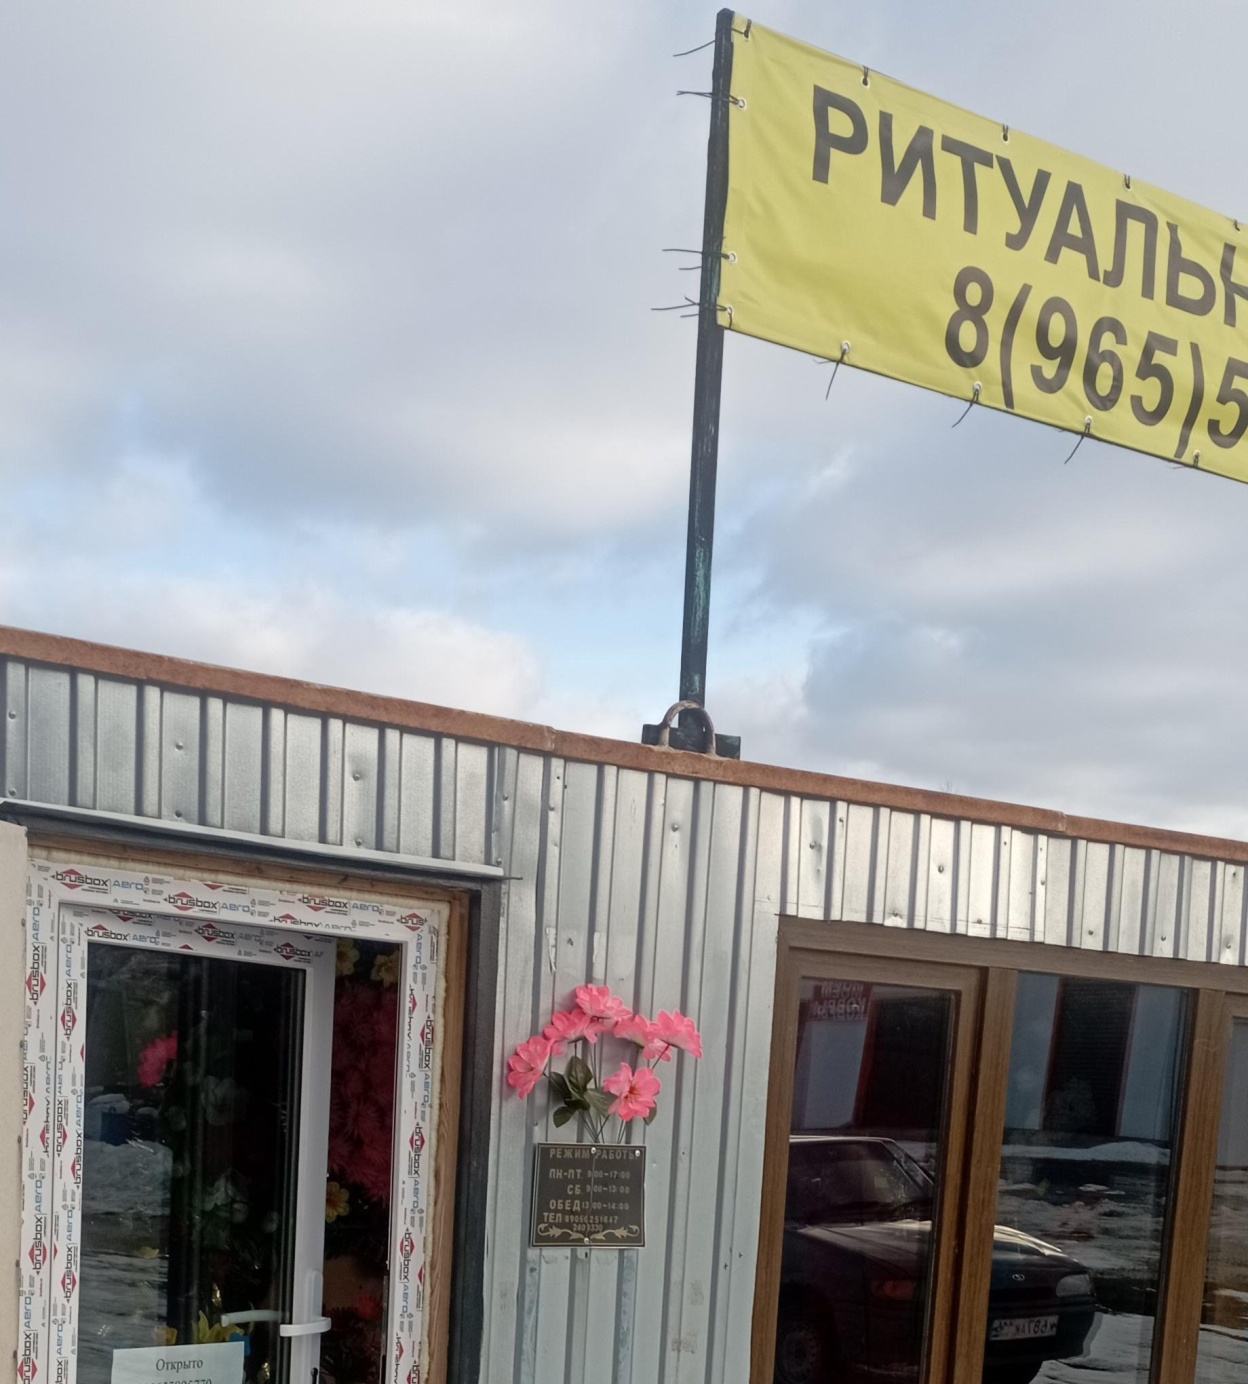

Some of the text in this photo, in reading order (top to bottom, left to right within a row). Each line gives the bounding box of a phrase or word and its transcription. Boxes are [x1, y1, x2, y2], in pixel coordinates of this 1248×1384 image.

[945, 266, 1248, 459] 8(965)5
[550, 1148, 590, 1159] РЕЖИМ
[549, 1200, 581, 1212] ОБЕД
[156, 1358, 203, 1373] Открыто
